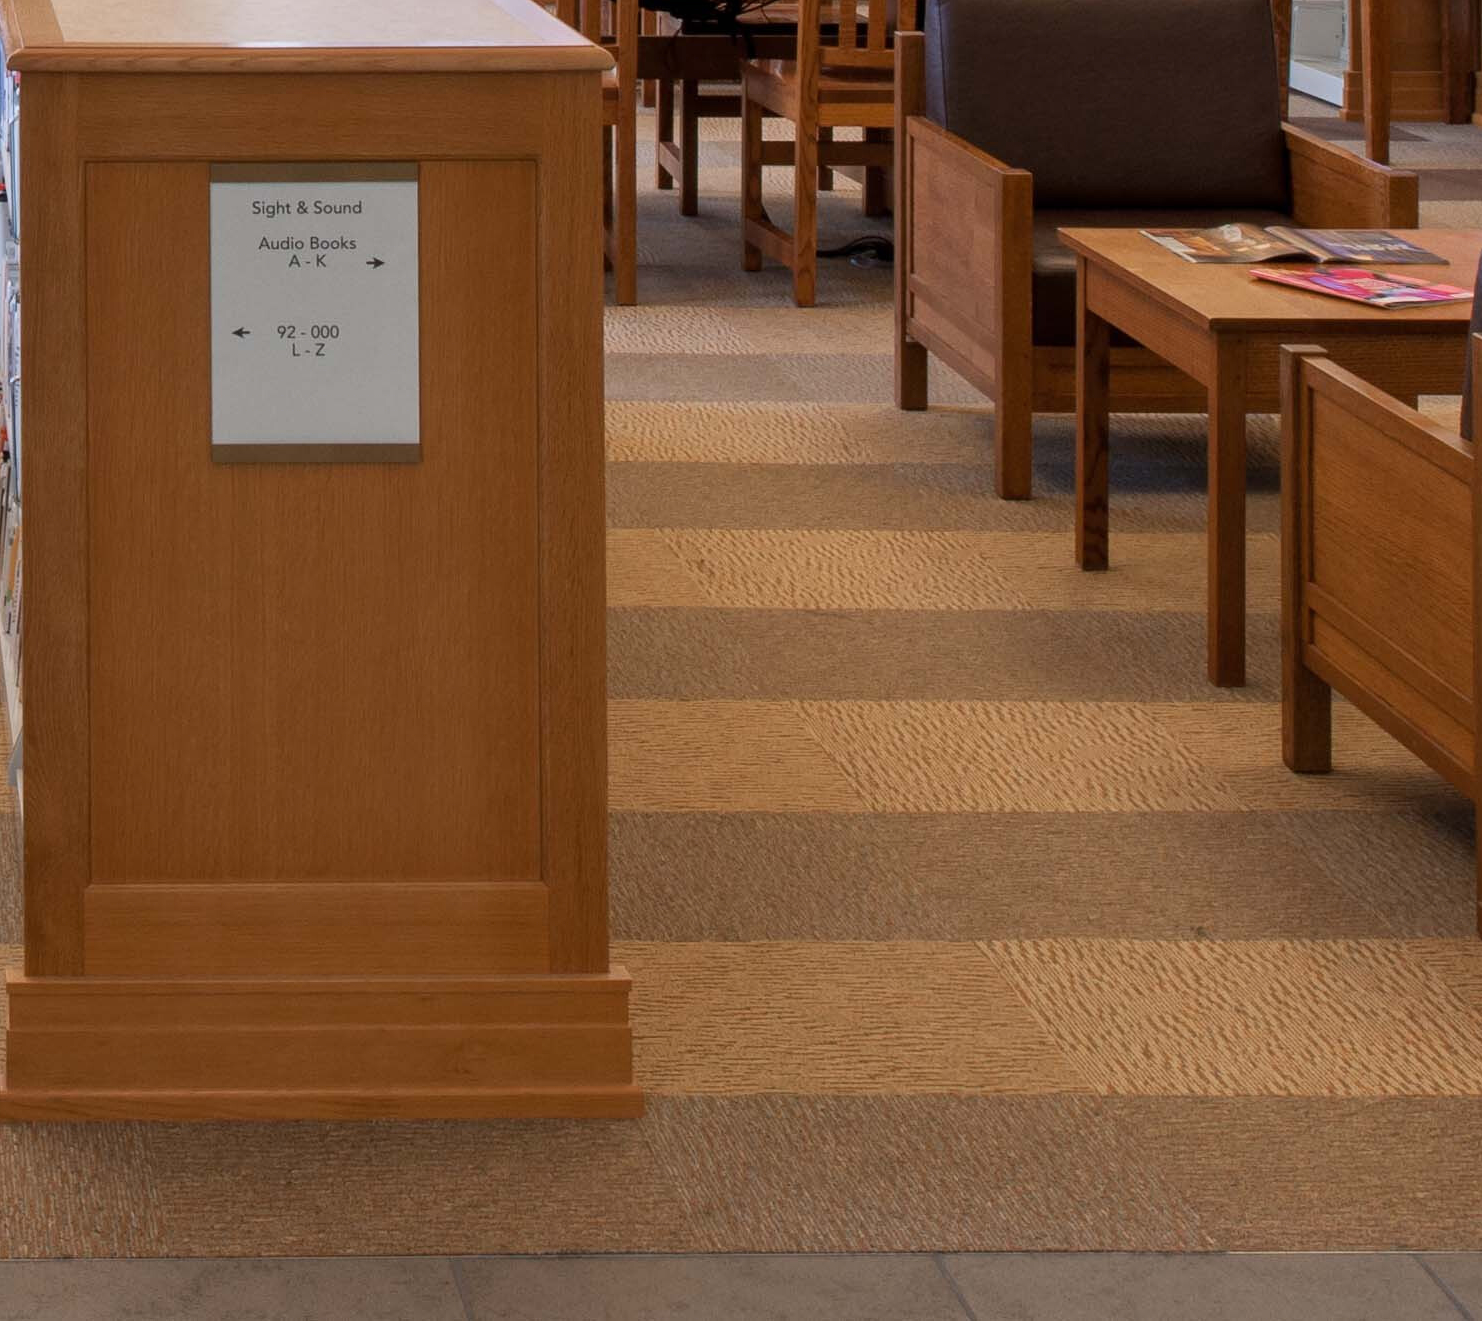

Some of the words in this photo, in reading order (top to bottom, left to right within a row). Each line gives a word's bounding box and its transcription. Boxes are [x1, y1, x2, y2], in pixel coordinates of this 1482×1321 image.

[252, 201, 292, 218] Sight
[296, 201, 309, 215] &
[313, 201, 363, 215] Sound
[258, 236, 305, 251] Audio
[309, 236, 357, 251] Books
[288, 254, 301, 268] A
[316, 254, 328, 268] K
[276, 325, 297, 339] 92
[310, 325, 340, 339] 000
[292, 343, 301, 357] L
[315, 343, 326, 357] Z
